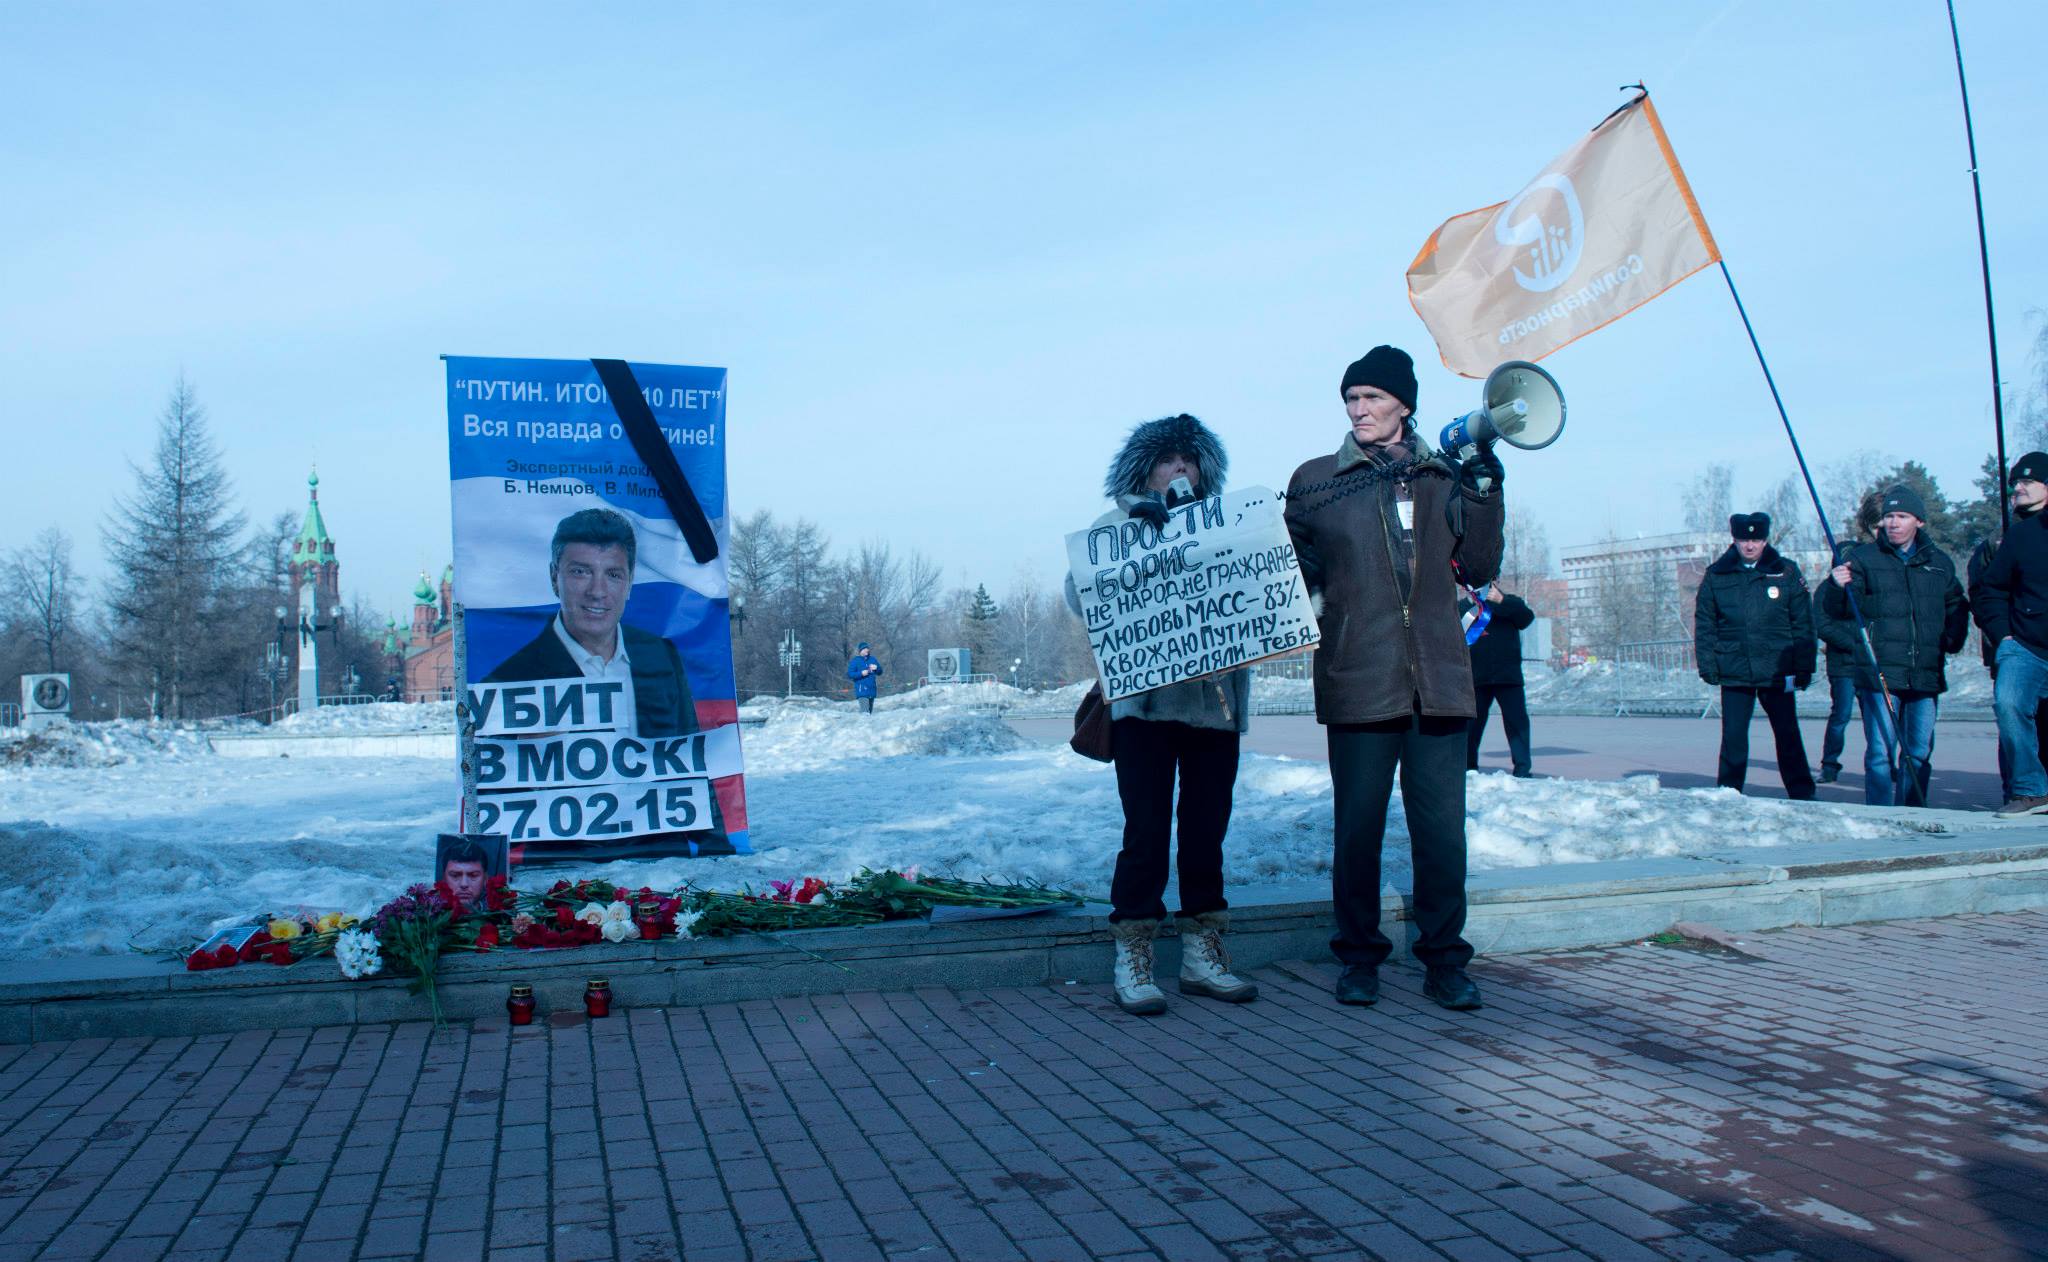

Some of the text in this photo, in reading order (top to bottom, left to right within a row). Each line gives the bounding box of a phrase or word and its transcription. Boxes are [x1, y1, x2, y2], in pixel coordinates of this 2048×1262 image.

[644, 387, 663, 407] 10
[464, 414, 508, 438] Вся
[517, 420, 602, 444] правда
[609, 425, 623, 440] о
[507, 459, 614, 477] Экспертный
[504, 479, 522, 494] Б.
[527, 481, 600, 497] Немцов,
[605, 482, 623, 496] В.
[467, 682, 623, 729] УБИТ
[476, 742, 506, 783] В
[478, 786, 697, 839] 27.02.15
